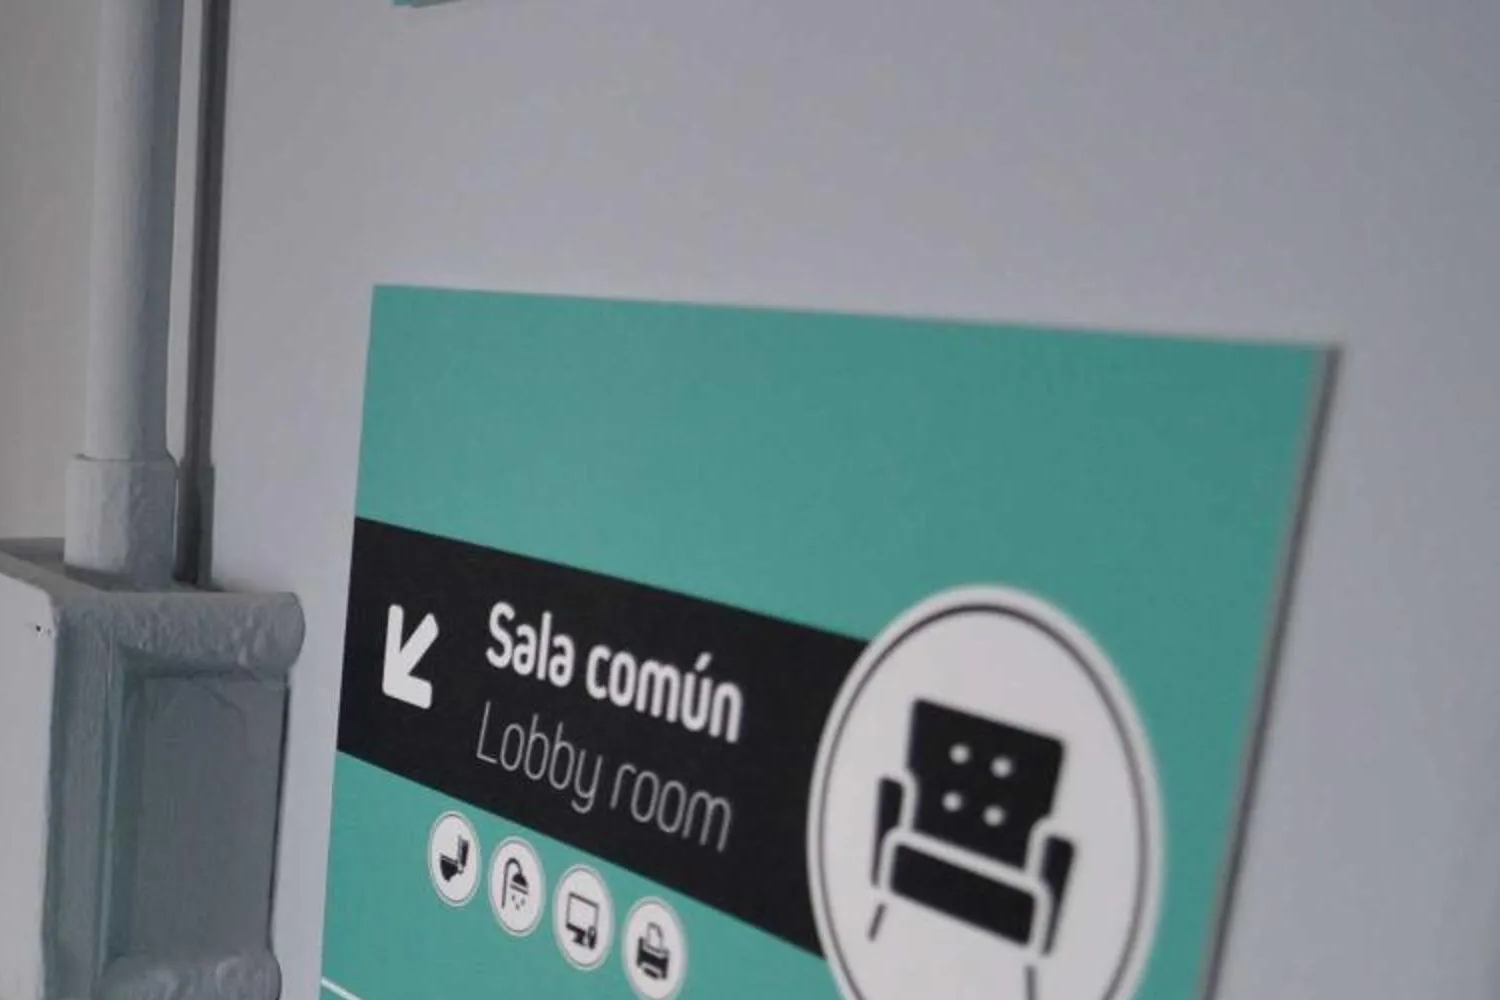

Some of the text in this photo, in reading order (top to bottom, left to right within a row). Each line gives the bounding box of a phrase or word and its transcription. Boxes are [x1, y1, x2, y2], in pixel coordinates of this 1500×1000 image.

[485, 600, 744, 744] Sala común
[475, 701, 732, 853] Lobby room
